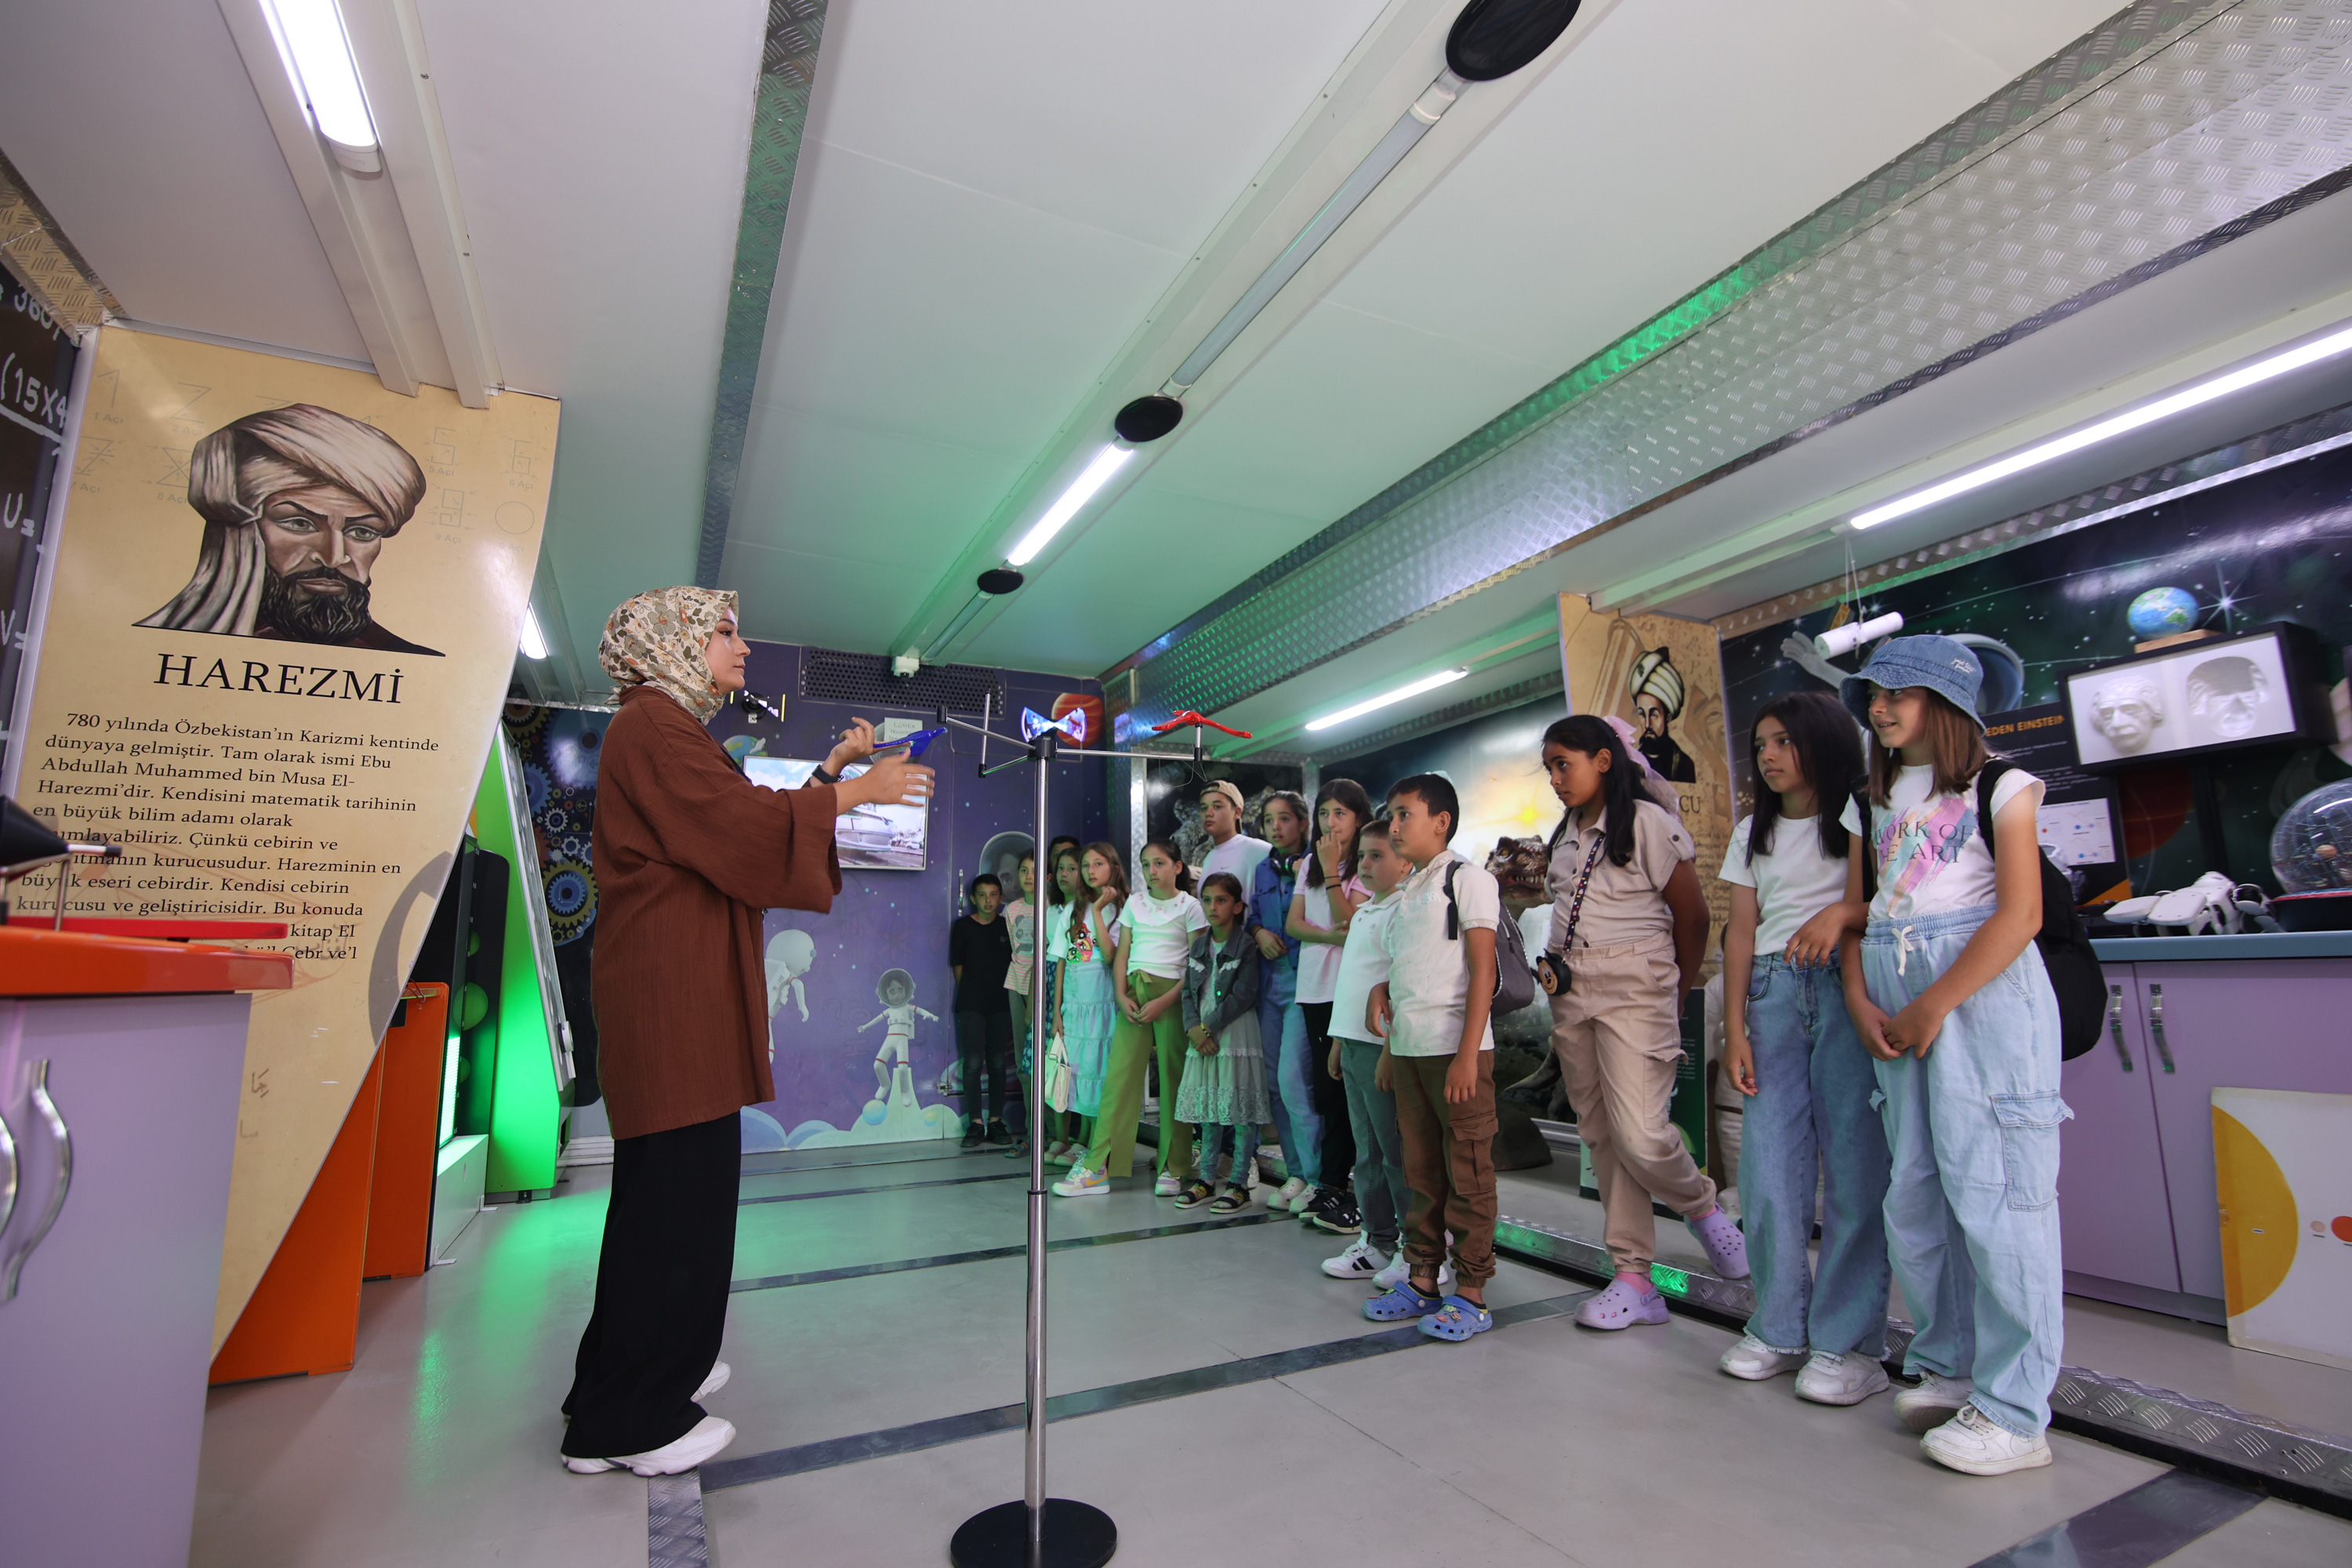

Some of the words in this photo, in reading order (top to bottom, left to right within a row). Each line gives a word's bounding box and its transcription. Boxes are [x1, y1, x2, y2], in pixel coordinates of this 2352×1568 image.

[153, 652, 405, 704] HAREZMİ
[67, 713, 100, 728] 780
[104, 717, 169, 733] yılında
[299, 729, 365, 746] Karizmi
[368, 734, 439, 751] kentinde
[45, 734, 125, 755] dünyaya
[129, 740, 214, 760] gelmiştir.
[220, 746, 259, 760] Tam
[263, 749, 316, 764] olarak
[320, 752, 355, 767] ismi
[360, 754, 391, 769] Ebu
[40, 757, 129, 775] Abdullah
[133, 762, 243, 781] Muhammed
[248, 768, 276, 783] bin
[281, 771, 326, 786] Musa
[330, 774, 355, 787] El-
[161, 786, 245, 803] Kendisini
[250, 794, 341, 808] matematik
[346, 797, 416, 811] tarihinin
[33, 806, 56, 817] en
[63, 803, 122, 822] büyük
[129, 806, 176, 822] bilim
[180, 809, 234, 825] adamı
[240, 812, 293, 827] olarak
[189, 832, 249, 849] Çünkü
[253, 835, 314, 850] cebirin
[319, 841, 338, 851] ve
[1939, 823, 1977, 842] OF
[152, 852, 270, 870] kurucusudur.
[276, 857, 377, 873] Harezminin
[381, 865, 401, 874] en
[1908, 843, 1964, 863] ART
[21, 873, 82, 892] büyk
[88, 875, 132, 889] eseri
[137, 876, 213, 891] cebirdir.
[220, 877, 285, 893] Kendisi
[290, 880, 350, 894] cebirin
[112, 902, 134, 912] ve
[138, 898, 267, 916] geliştiricisidir.
[272, 901, 296, 915] Bu
[300, 901, 363, 916] konuda
[289, 923, 333, 942] kitap
[336, 924, 355, 938] El
